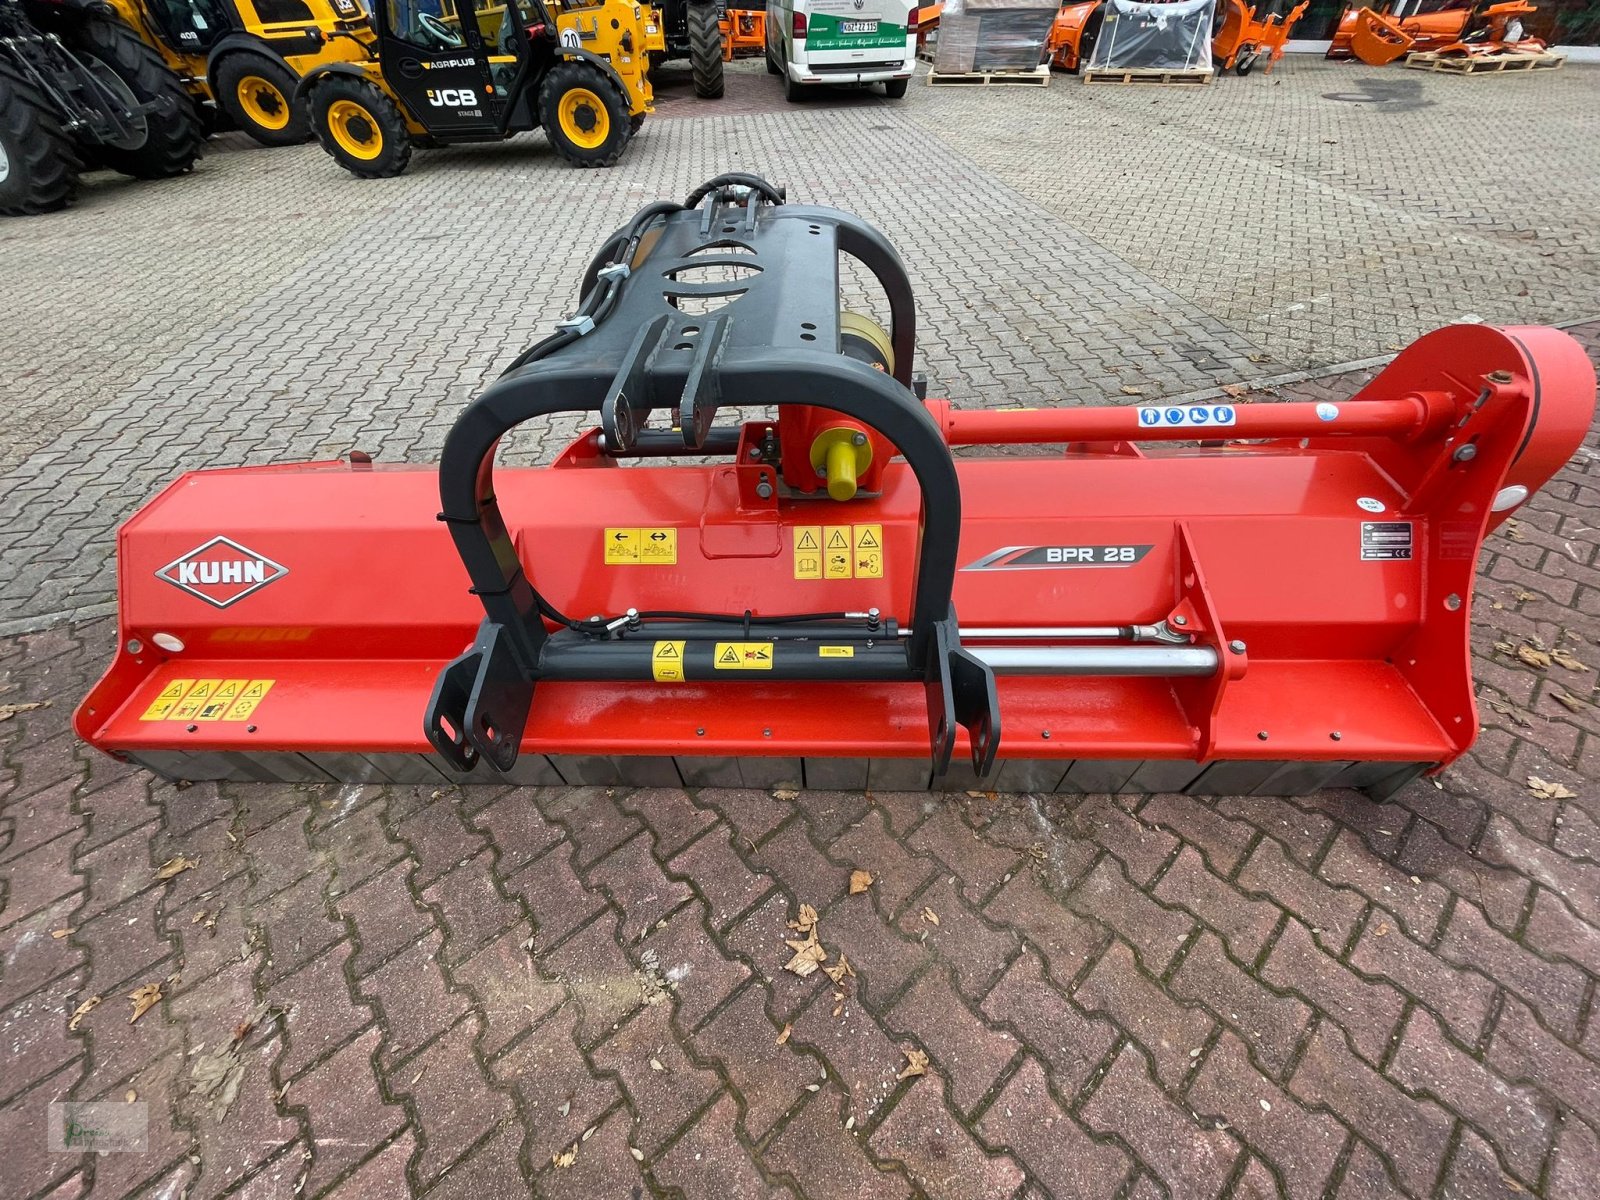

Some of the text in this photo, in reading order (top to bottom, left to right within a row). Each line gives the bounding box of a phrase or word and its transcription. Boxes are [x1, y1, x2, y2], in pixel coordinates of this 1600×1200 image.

[867, 22, 877, 31] 115
[563, 33, 579, 48] 20
[427, 89, 478, 107] JCB
[1046, 547, 1136, 562] BPR 28
[178, 560, 265, 584] KUHN
